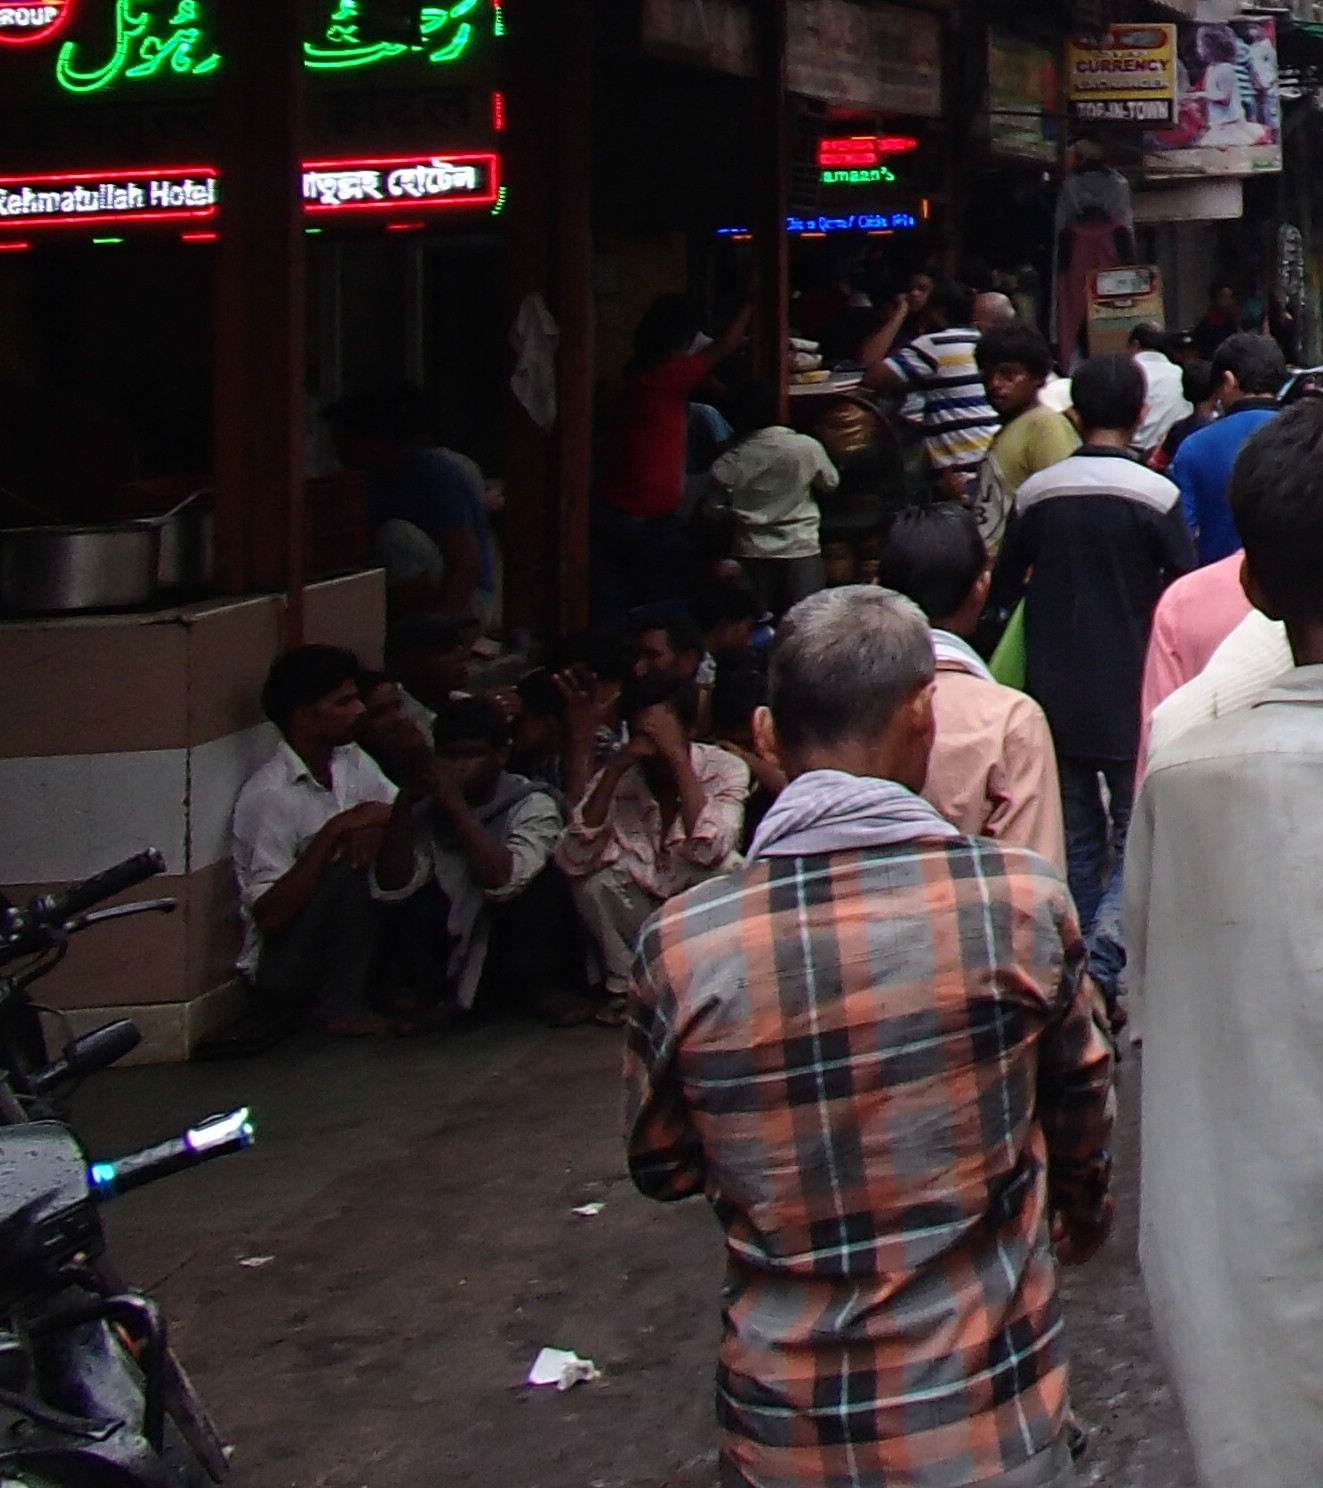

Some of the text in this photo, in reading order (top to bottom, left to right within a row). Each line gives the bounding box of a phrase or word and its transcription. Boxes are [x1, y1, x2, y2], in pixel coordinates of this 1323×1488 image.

[0, 6, 59, 26] ROUP
[1076, 59, 1169, 73] CURRENCY
[150, 177, 217, 207] Hotel
